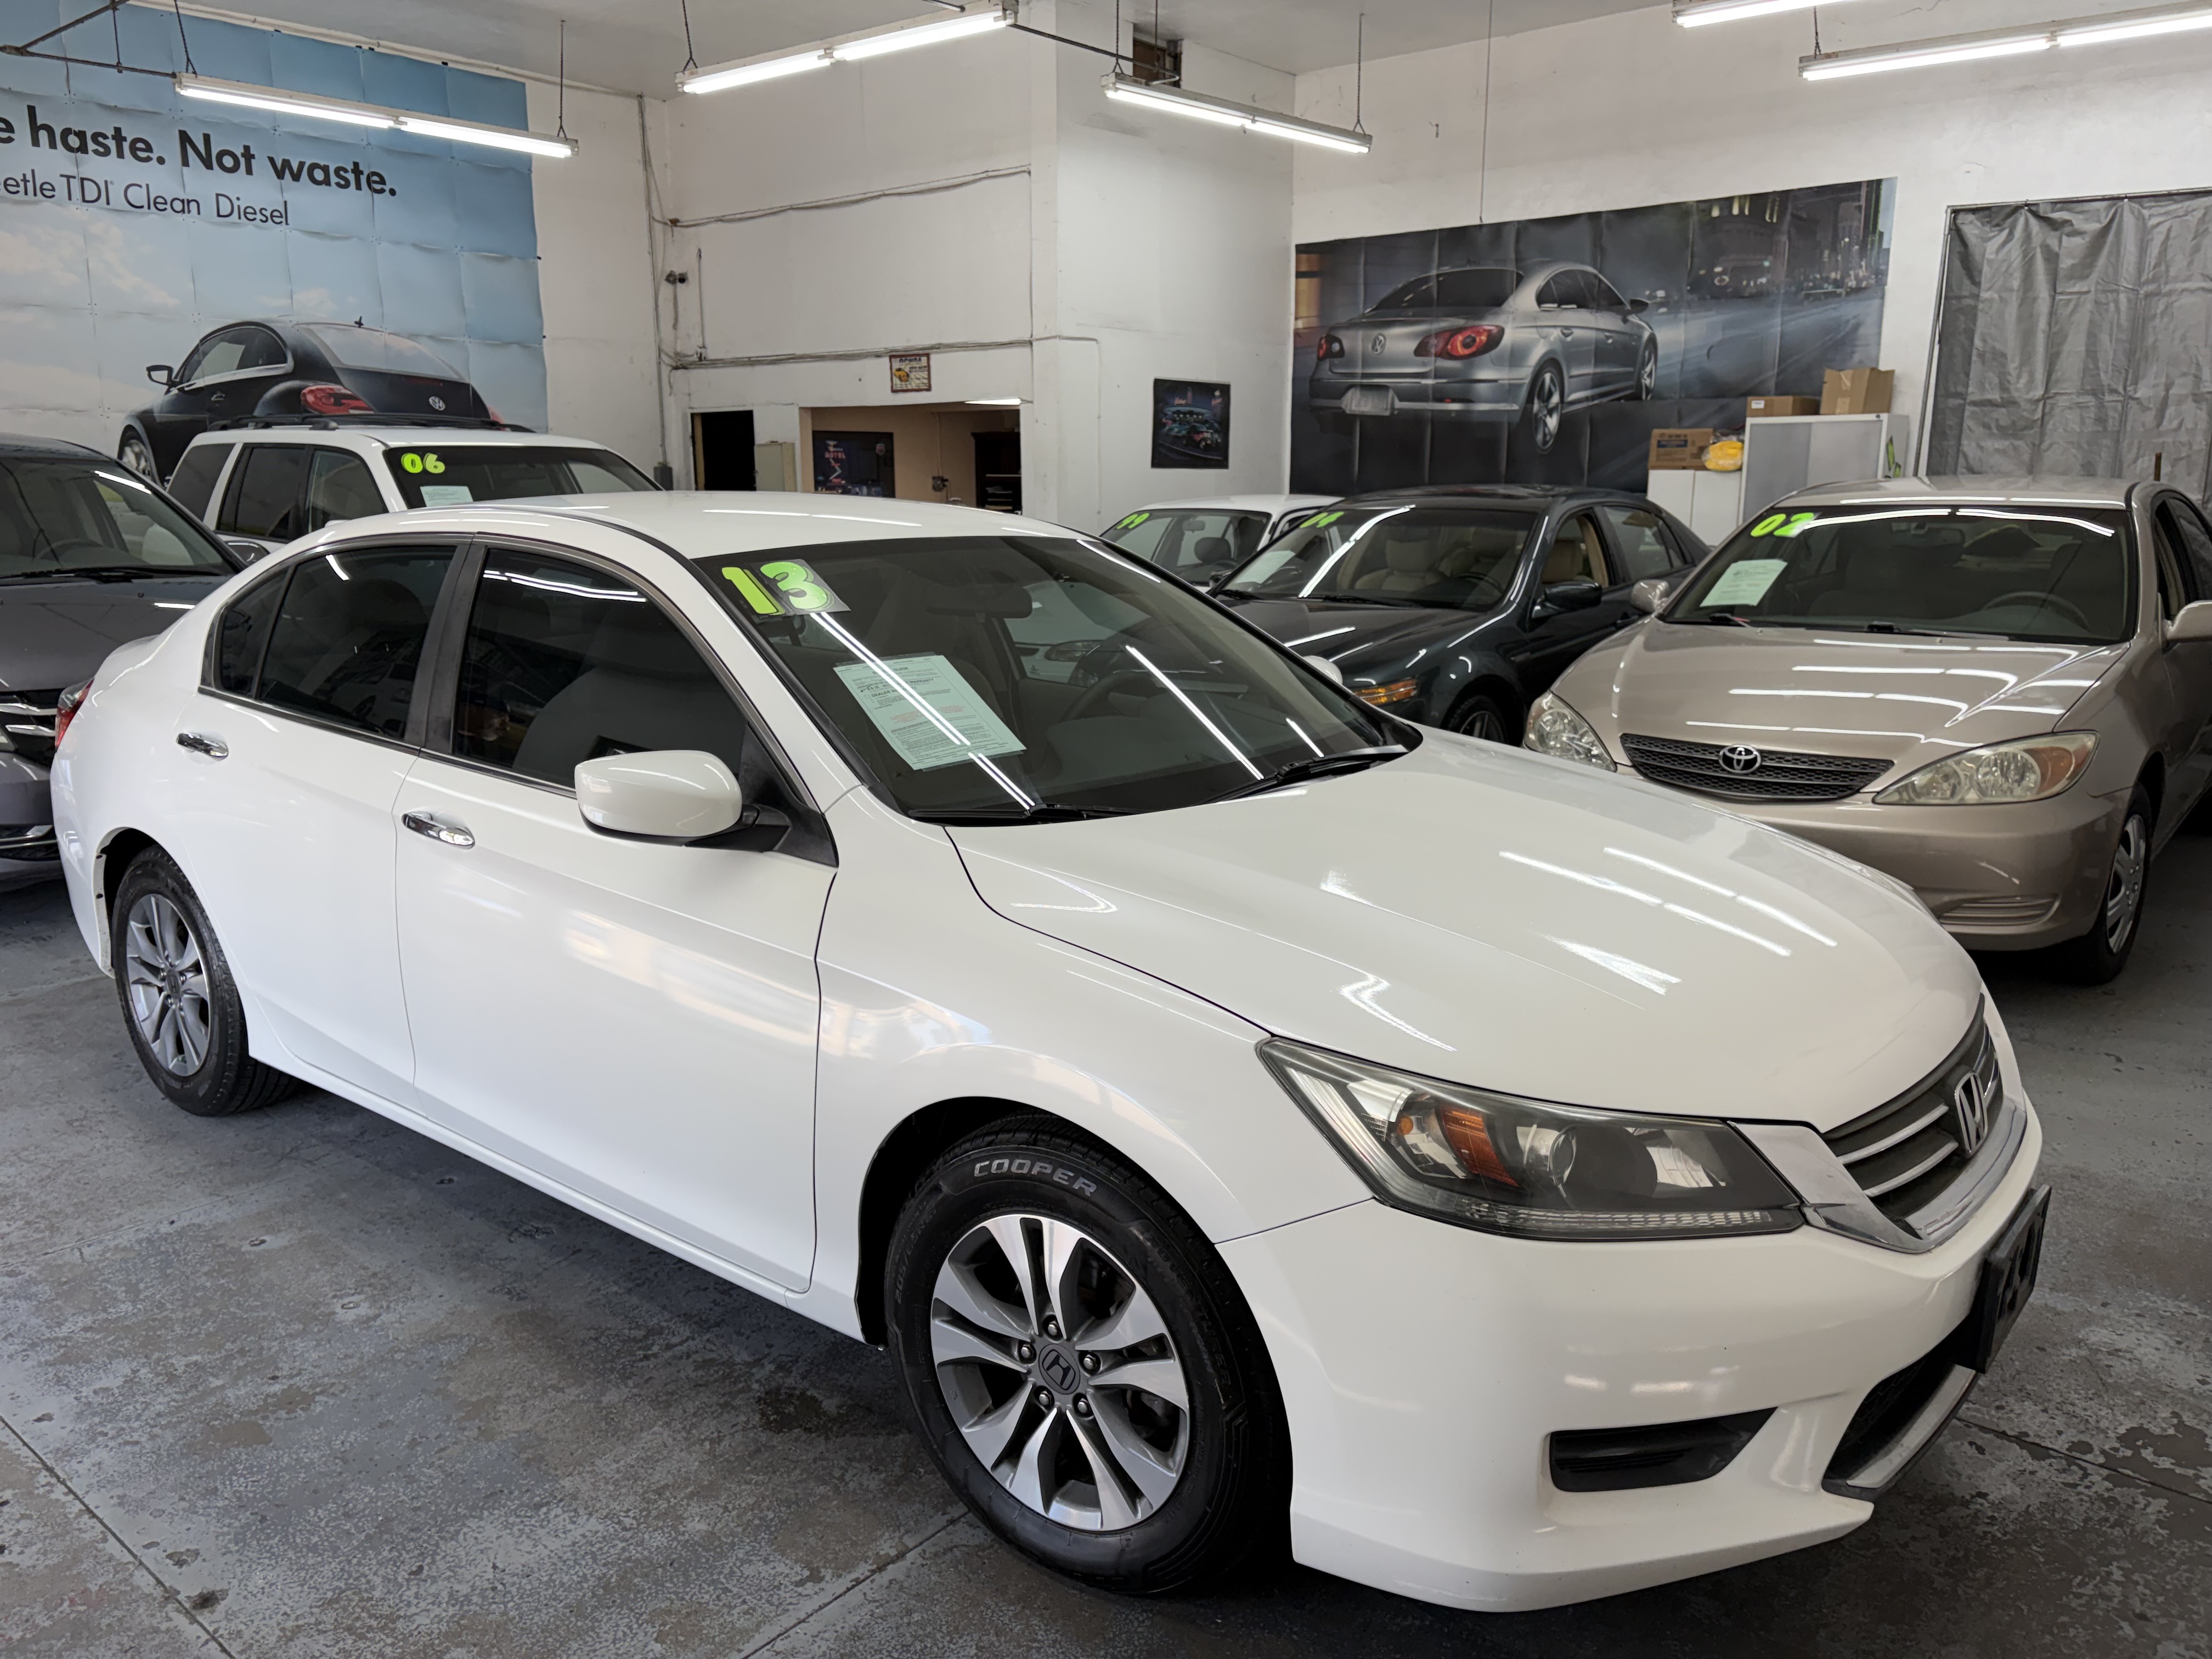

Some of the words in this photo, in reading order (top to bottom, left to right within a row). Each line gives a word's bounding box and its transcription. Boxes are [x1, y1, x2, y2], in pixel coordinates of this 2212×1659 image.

[27, 104, 166, 165] haste.
[178, 129, 255, 176] Not
[267, 156, 397, 196] waste.
[0, 168, 56, 199] etle
[123, 183, 201, 216] Clean
[215, 193, 290, 225] Diesel
[401, 453, 445, 474] 06
[1116, 513, 1150, 529] 99
[1750, 512, 1814, 538] 02
[722, 561, 833, 615] 13
[974, 1159, 1097, 1197] COOPER
